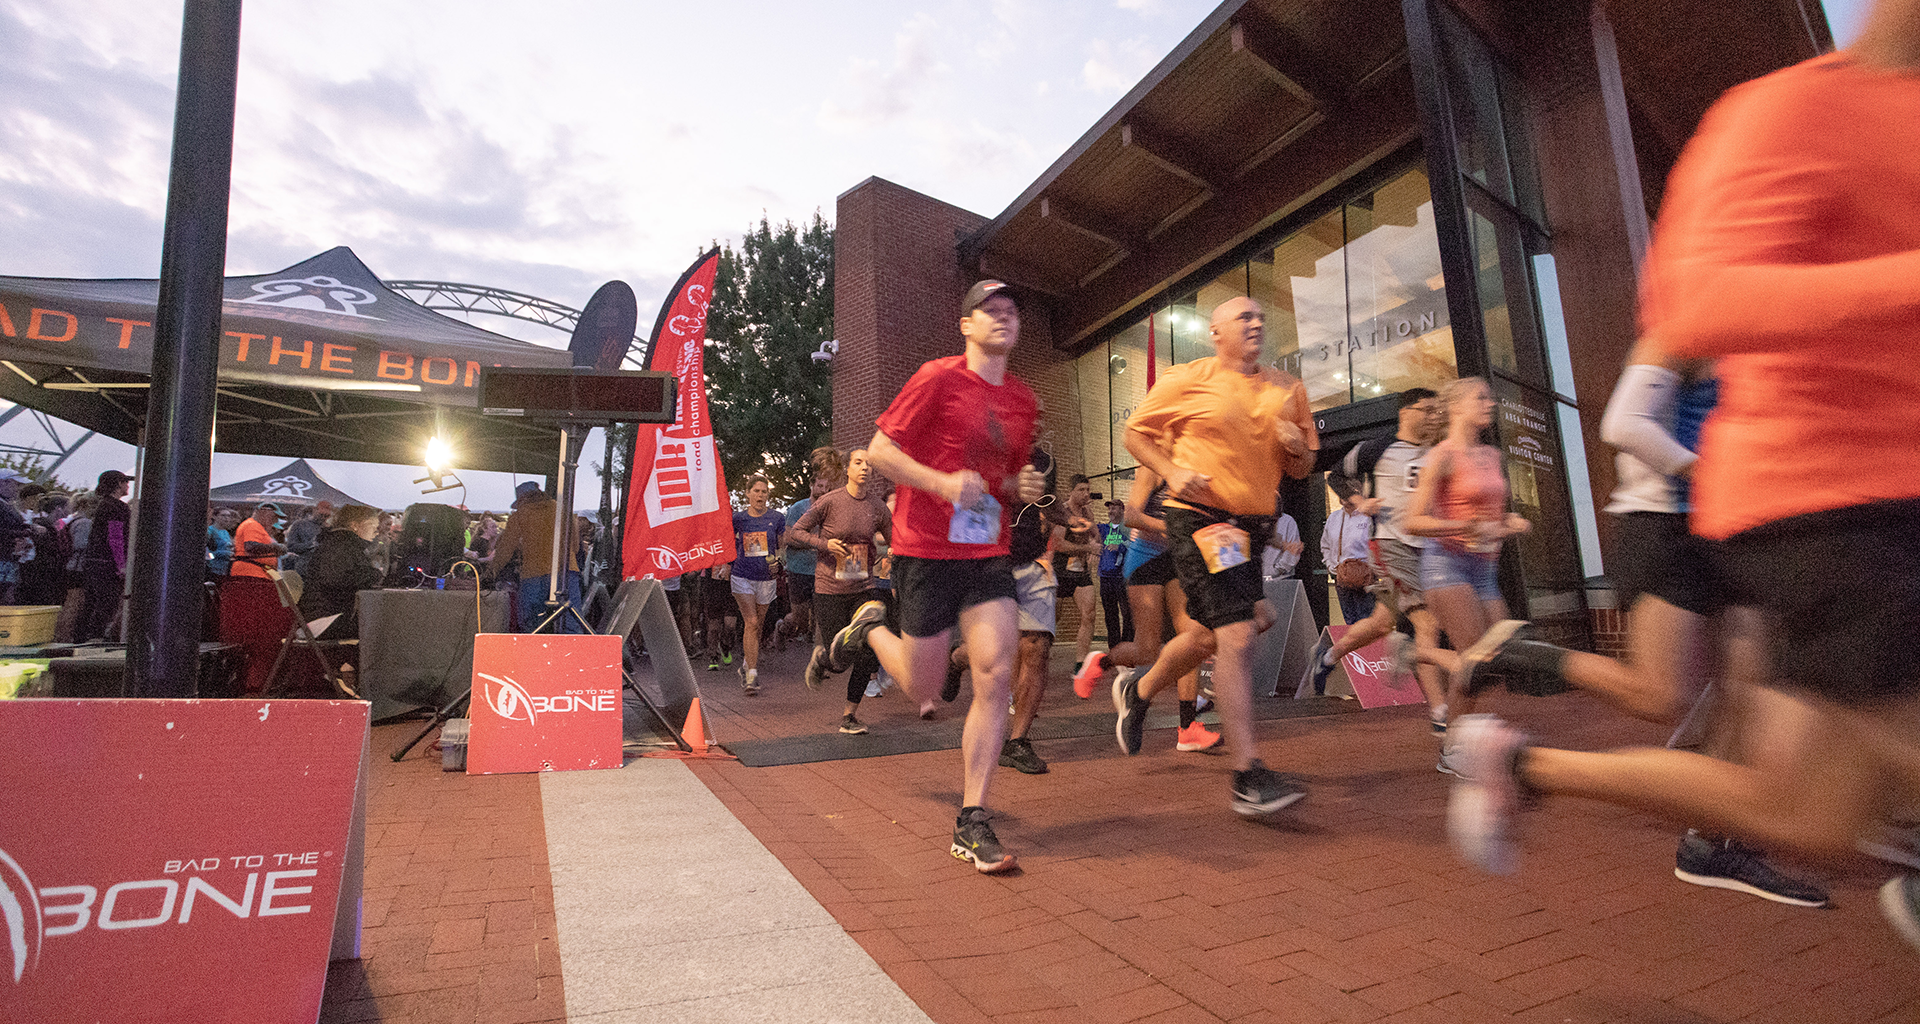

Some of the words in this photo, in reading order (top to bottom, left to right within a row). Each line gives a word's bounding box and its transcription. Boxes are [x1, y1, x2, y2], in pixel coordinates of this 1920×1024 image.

[0, 302, 78, 342] AD
[106, 317, 151, 350] T
[224, 331, 357, 374] THE
[377, 350, 486, 388] BON
[1319, 311, 1436, 361] STATION
[689, 346, 701, 436] championship
[1505, 412, 1521, 424] AREA
[692, 441, 702, 472] road
[1508, 445, 1532, 459] VISITOR
[1533, 452, 1554, 465] CENTER
[678, 541, 724, 564] BONE
[531, 695, 615, 713] BONE
[163, 857, 220, 873] BAD
[230, 854, 264, 870] TO
[272, 851, 320, 867] THE
[40, 869, 318, 938] BONE
